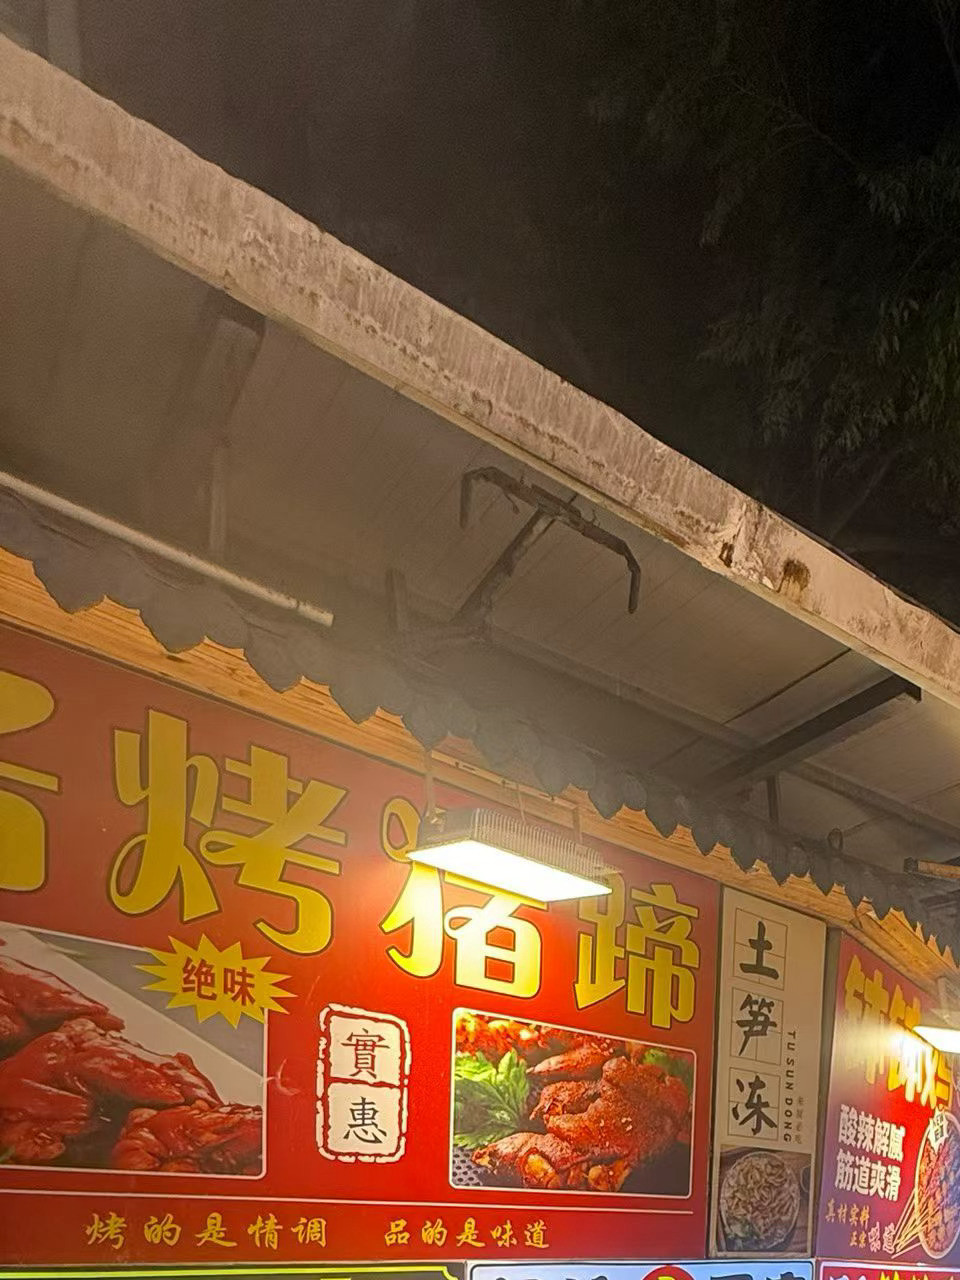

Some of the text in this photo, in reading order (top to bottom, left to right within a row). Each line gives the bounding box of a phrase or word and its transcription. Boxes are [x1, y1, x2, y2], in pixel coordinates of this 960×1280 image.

[180, 955, 257, 1007] 绝味
[731, 920, 780, 1136] 土笋冻
[340, 1027, 392, 1146] 實惠
[834, 1149, 901, 1201] 筋道爽滑
[85, 1212, 550, 1250] 烤的是情调 品的是味道
